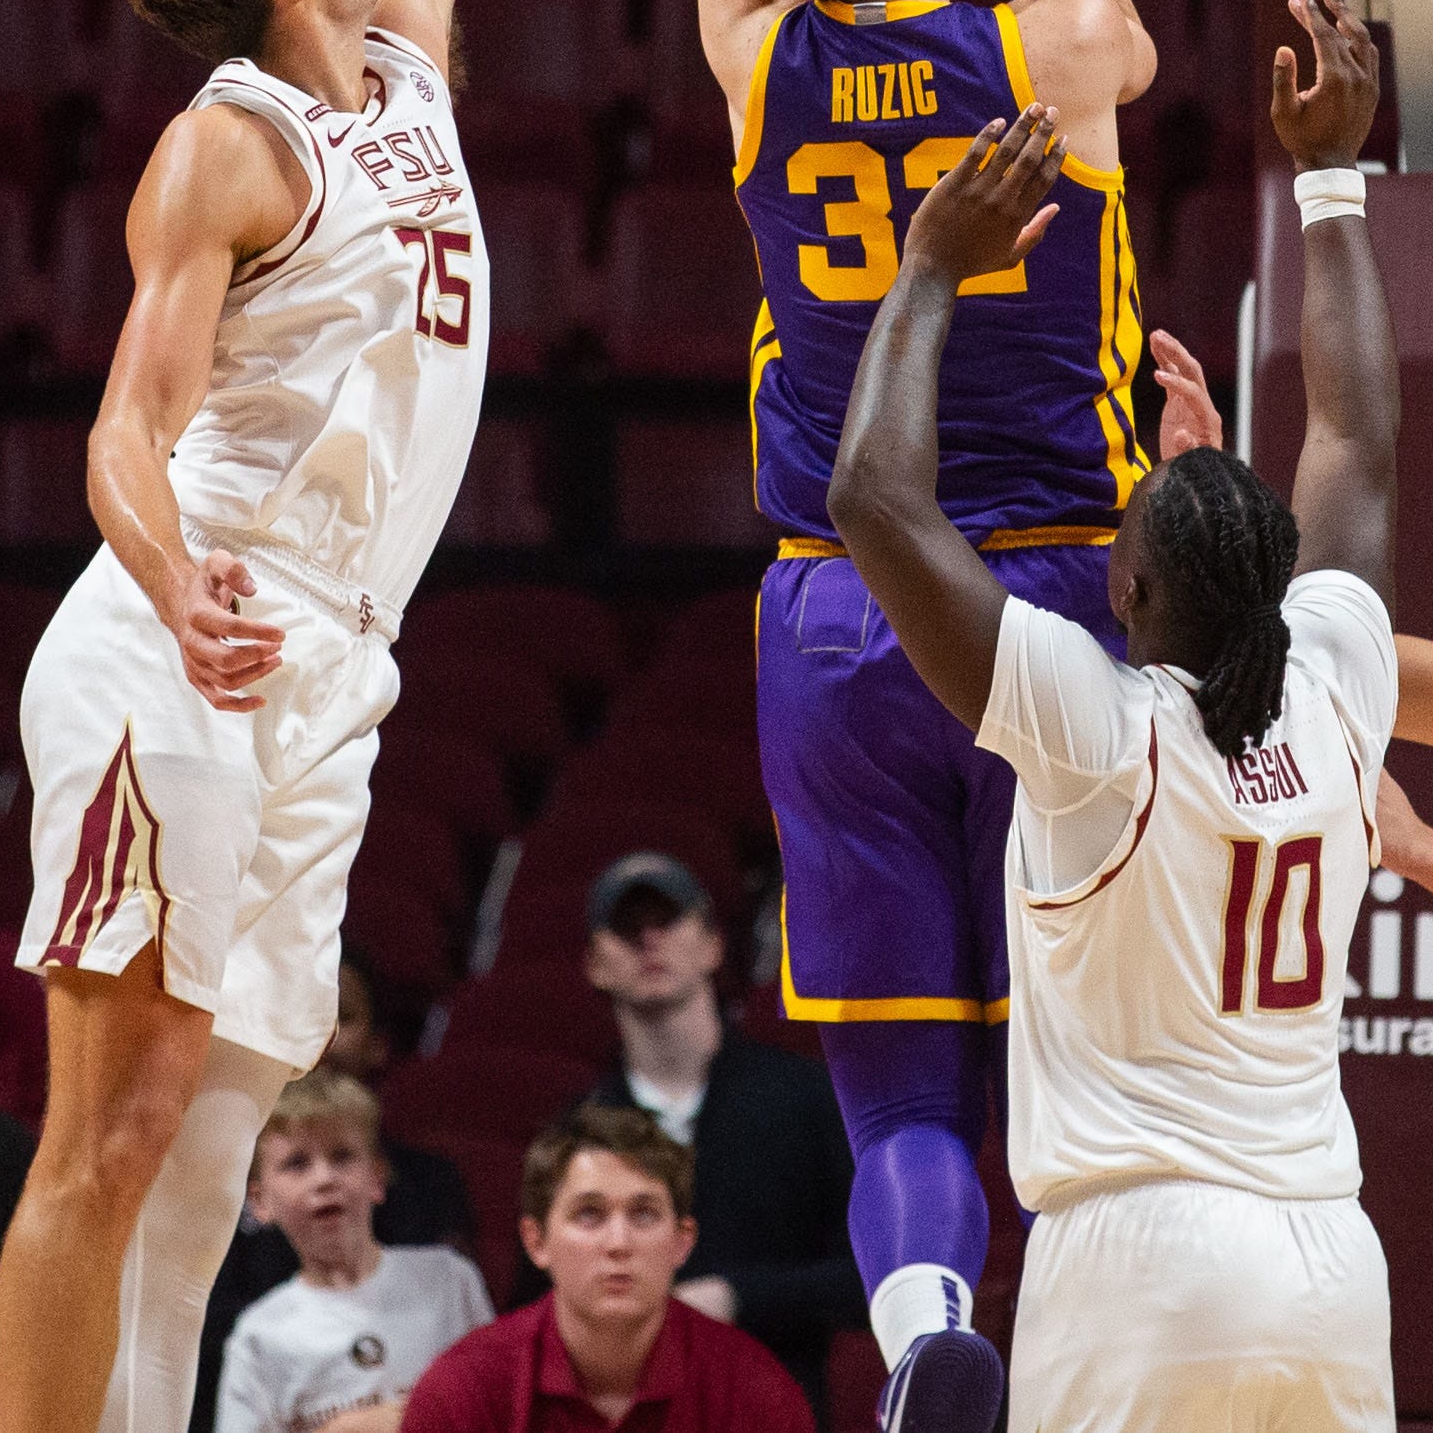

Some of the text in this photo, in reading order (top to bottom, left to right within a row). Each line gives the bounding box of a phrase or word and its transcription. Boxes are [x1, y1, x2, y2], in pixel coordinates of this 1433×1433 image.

[831, 60, 938, 123] RUZIC
[351, 125, 454, 191] FSU
[392, 225, 473, 349] 25
[1218, 832, 1325, 1017] 10
